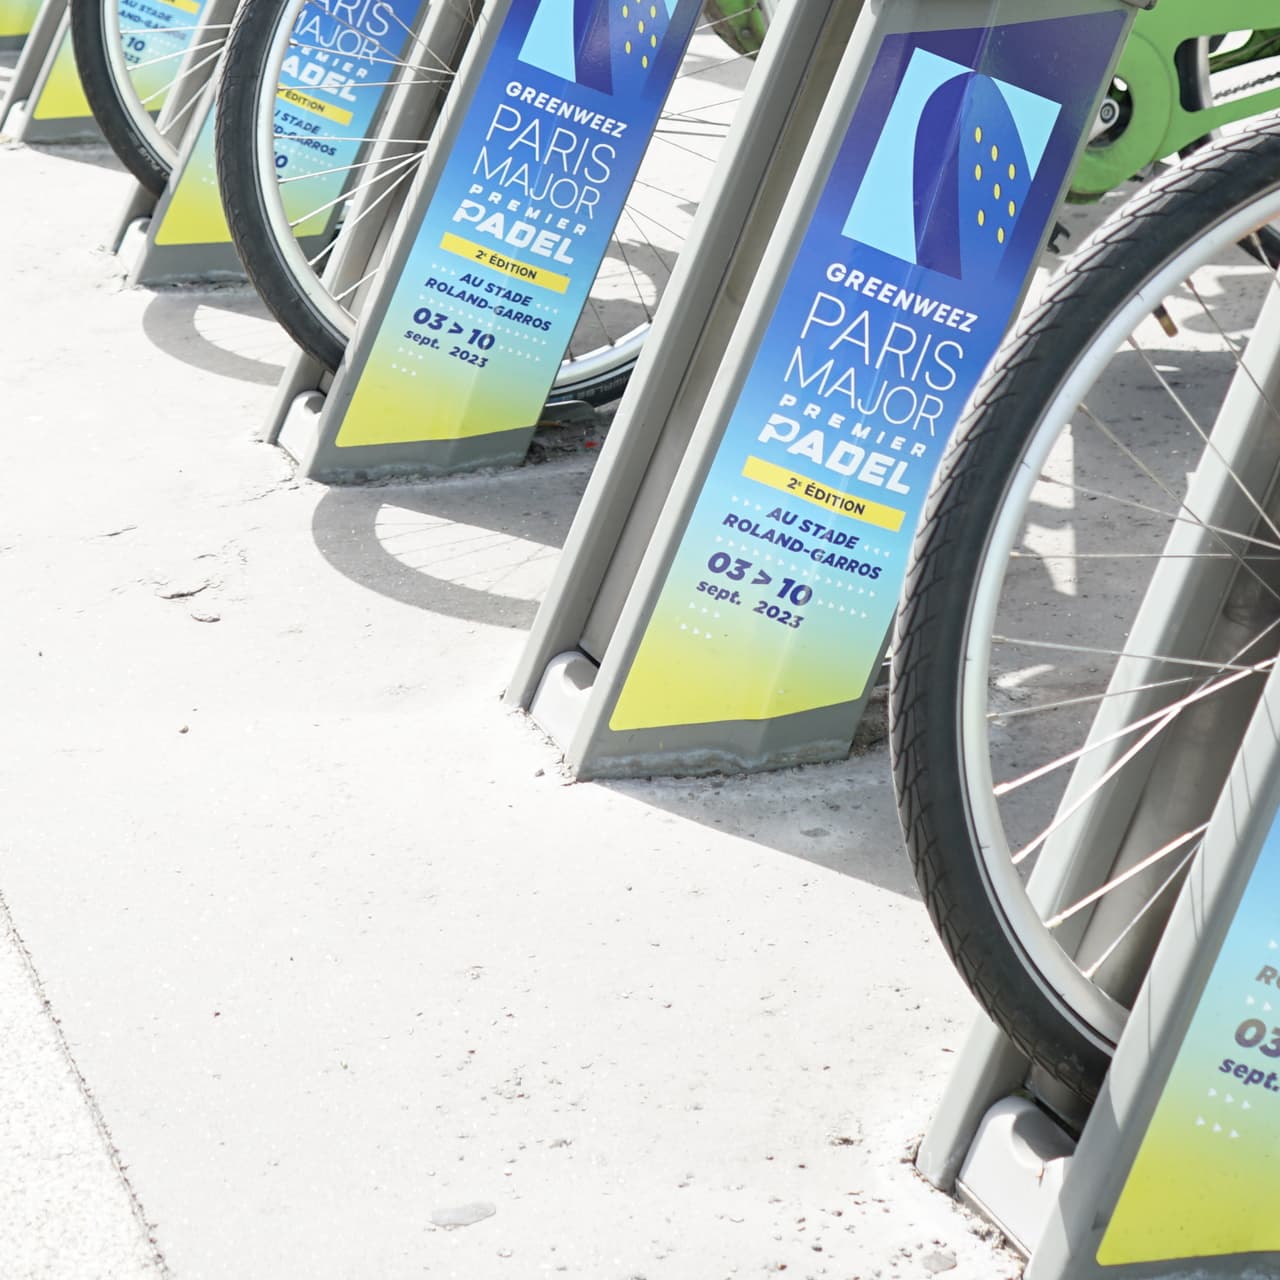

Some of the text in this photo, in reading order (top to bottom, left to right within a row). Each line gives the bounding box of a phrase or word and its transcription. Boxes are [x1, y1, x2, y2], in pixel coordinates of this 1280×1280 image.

[127, 37, 145, 52] 10
[281, 55, 357, 102] ADEL
[281, 113, 320, 136] STADE
[505, 81, 628, 139] GREENWEEZ
[485, 103, 616, 184] PARIS
[469, 183, 587, 236] PREMIER
[472, 145, 601, 220] MAJOR
[452, 199, 575, 265] PADEL
[459, 273, 533, 308] AU STADE
[488, 252, 538, 281] ÉDITION
[424, 277, 552, 332] ROLAND-GARROS
[826, 262, 978, 333] GREENWEEZ
[404, 328, 489, 369] sept. 2023
[800, 291, 964, 391] PARIS
[783, 345, 945, 437] MAJOR
[779, 393, 927, 458] PREMIER
[757, 413, 911, 495] PADEL
[804, 482, 866, 516] ÉDITION
[722, 513, 883, 581] ROLAND-GARROS
[766, 506, 860, 550] AU STADE
[695, 579, 805, 629] sept. 2023
[1218, 1058, 1280, 1092] sept.
